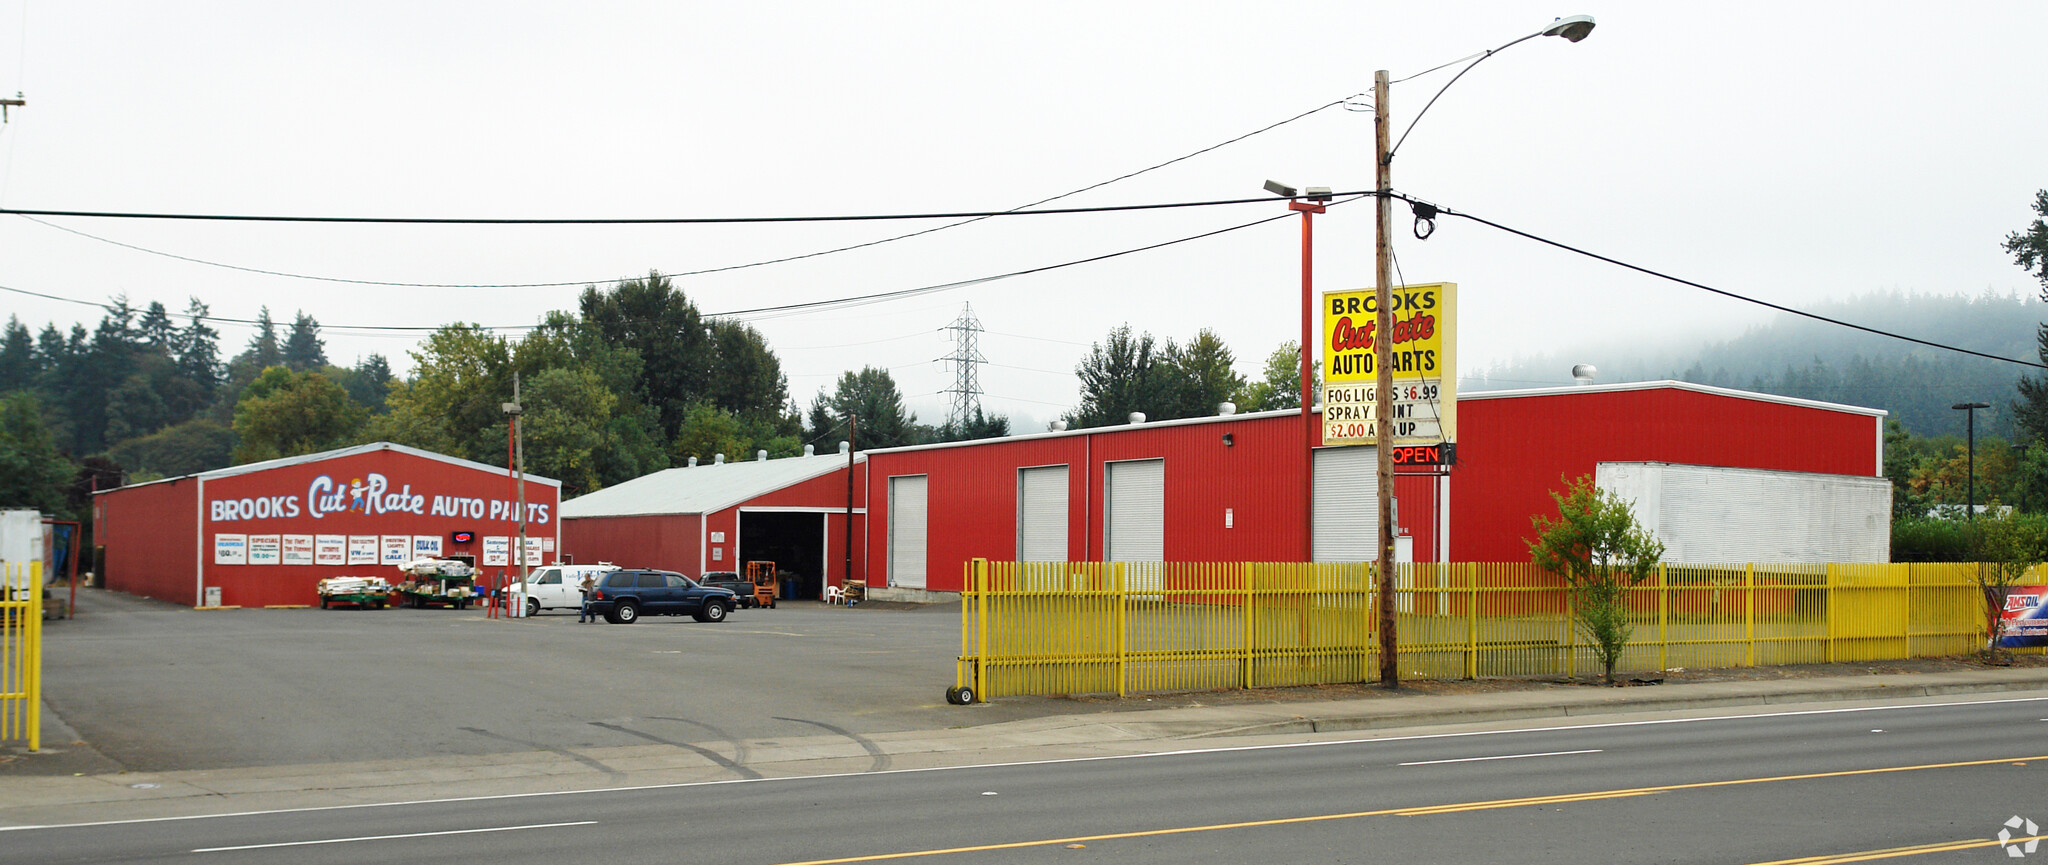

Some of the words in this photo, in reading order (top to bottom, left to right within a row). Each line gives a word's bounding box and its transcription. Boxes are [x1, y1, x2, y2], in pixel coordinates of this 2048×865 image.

[1332, 291, 1436, 316] BROOKS
[1331, 316, 1377, 353] Cut
[1373, 310, 1436, 354] ate
[1332, 353, 1374, 375] AUTO
[1391, 349, 1435, 373] ARTS
[1328, 389, 1351, 403] FOG
[1354, 386, 1399, 402] LIGS
[1403, 385, 1438, 400] $6.99
[1328, 405, 1370, 420] SPRAY
[1331, 423, 1365, 437] $2.00
[1399, 422, 1416, 436] UP
[1392, 447, 1439, 463] OPEN
[211, 495, 300, 522] BROOKS
[308, 474, 347, 519] Cut
[364, 472, 425, 516] Rate
[430, 495, 485, 520] AUTO
[2006, 596, 2039, 610] AMSOIL
